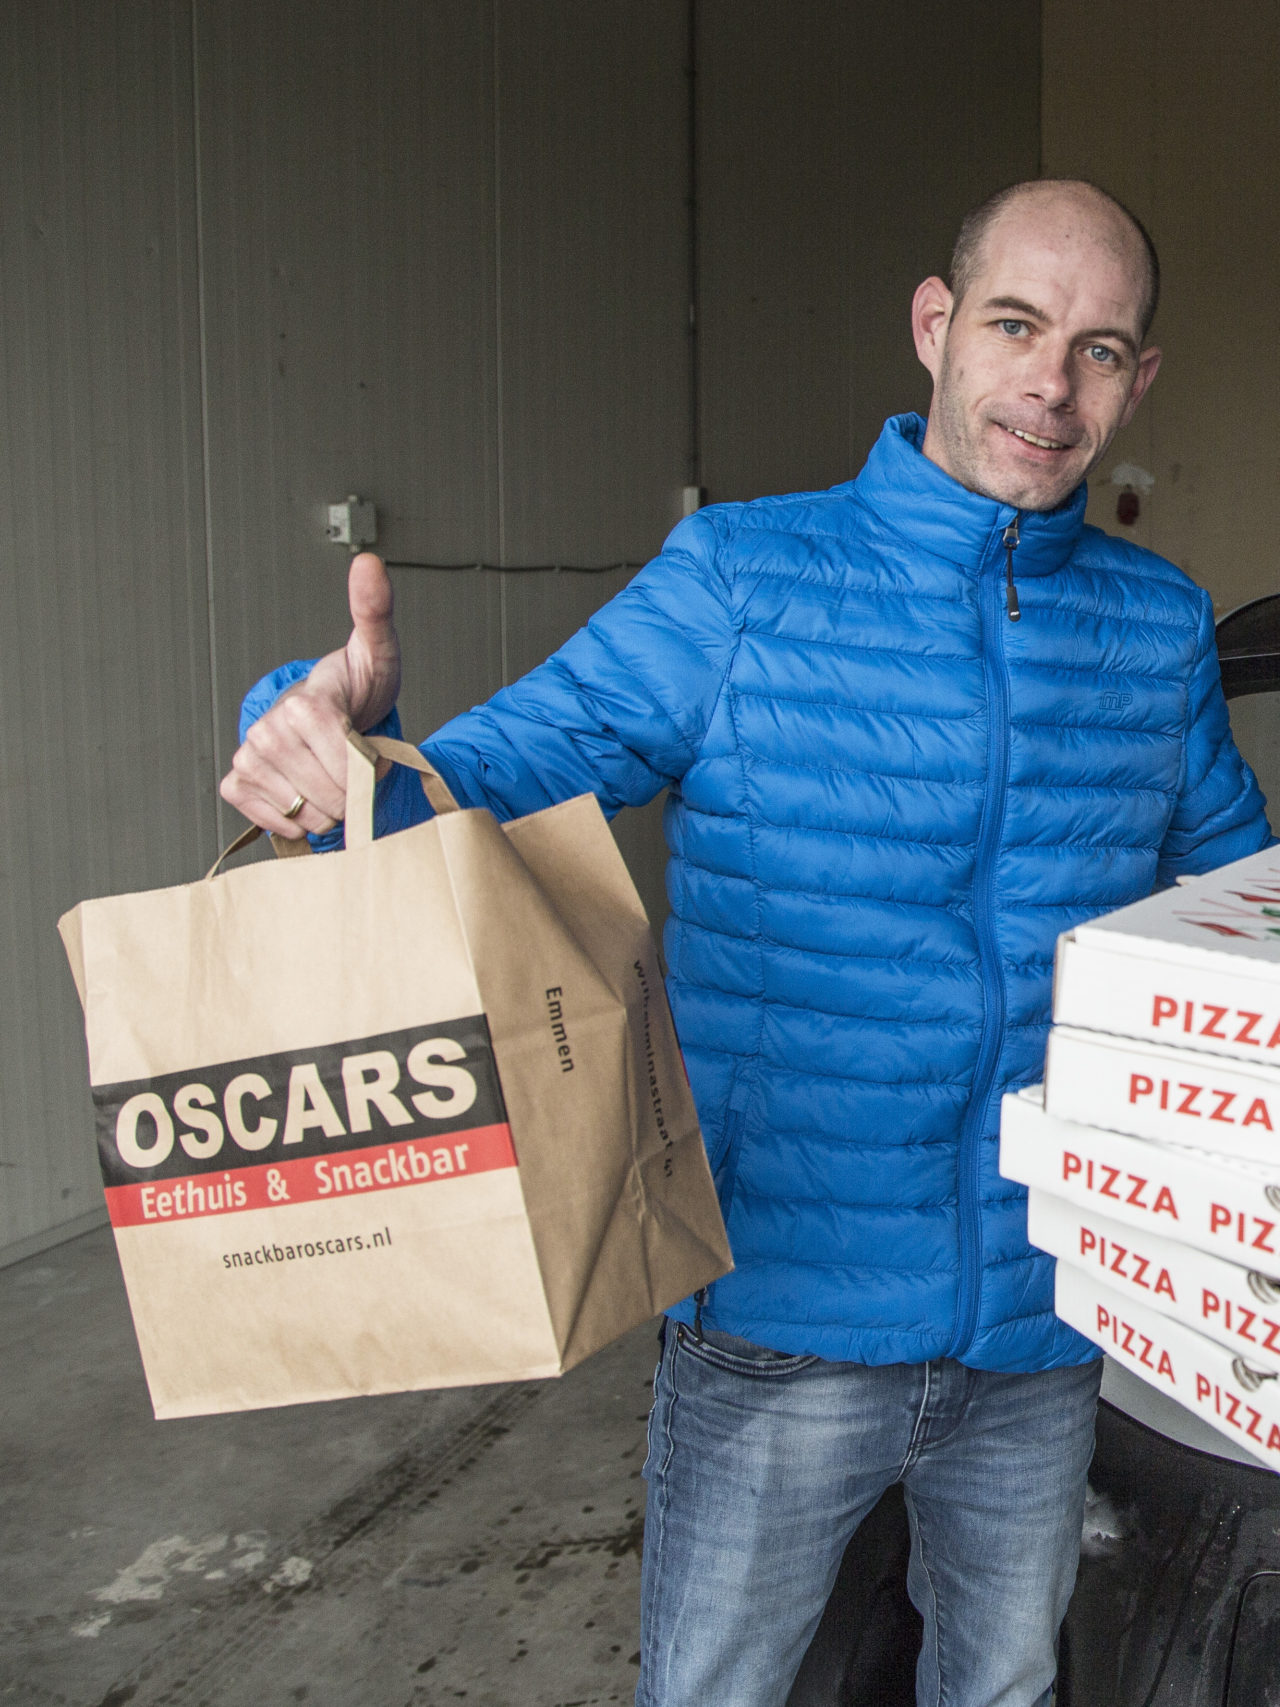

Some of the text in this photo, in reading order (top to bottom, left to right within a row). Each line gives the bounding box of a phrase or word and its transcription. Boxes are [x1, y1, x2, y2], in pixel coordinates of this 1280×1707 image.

[545, 986, 574, 1073] Emmen
[116, 1037, 477, 1168] OSCARS
[1129, 1074, 1273, 1131] PIZZA
[140, 1143, 470, 1219] Eethuis & Snackbar
[1063, 1152, 1179, 1220] PIZZA
[222, 1226, 393, 1269] snackbaroscars.nl
[1080, 1228, 1176, 1301] PIZZA
[1097, 1306, 1175, 1383] PIZZA
